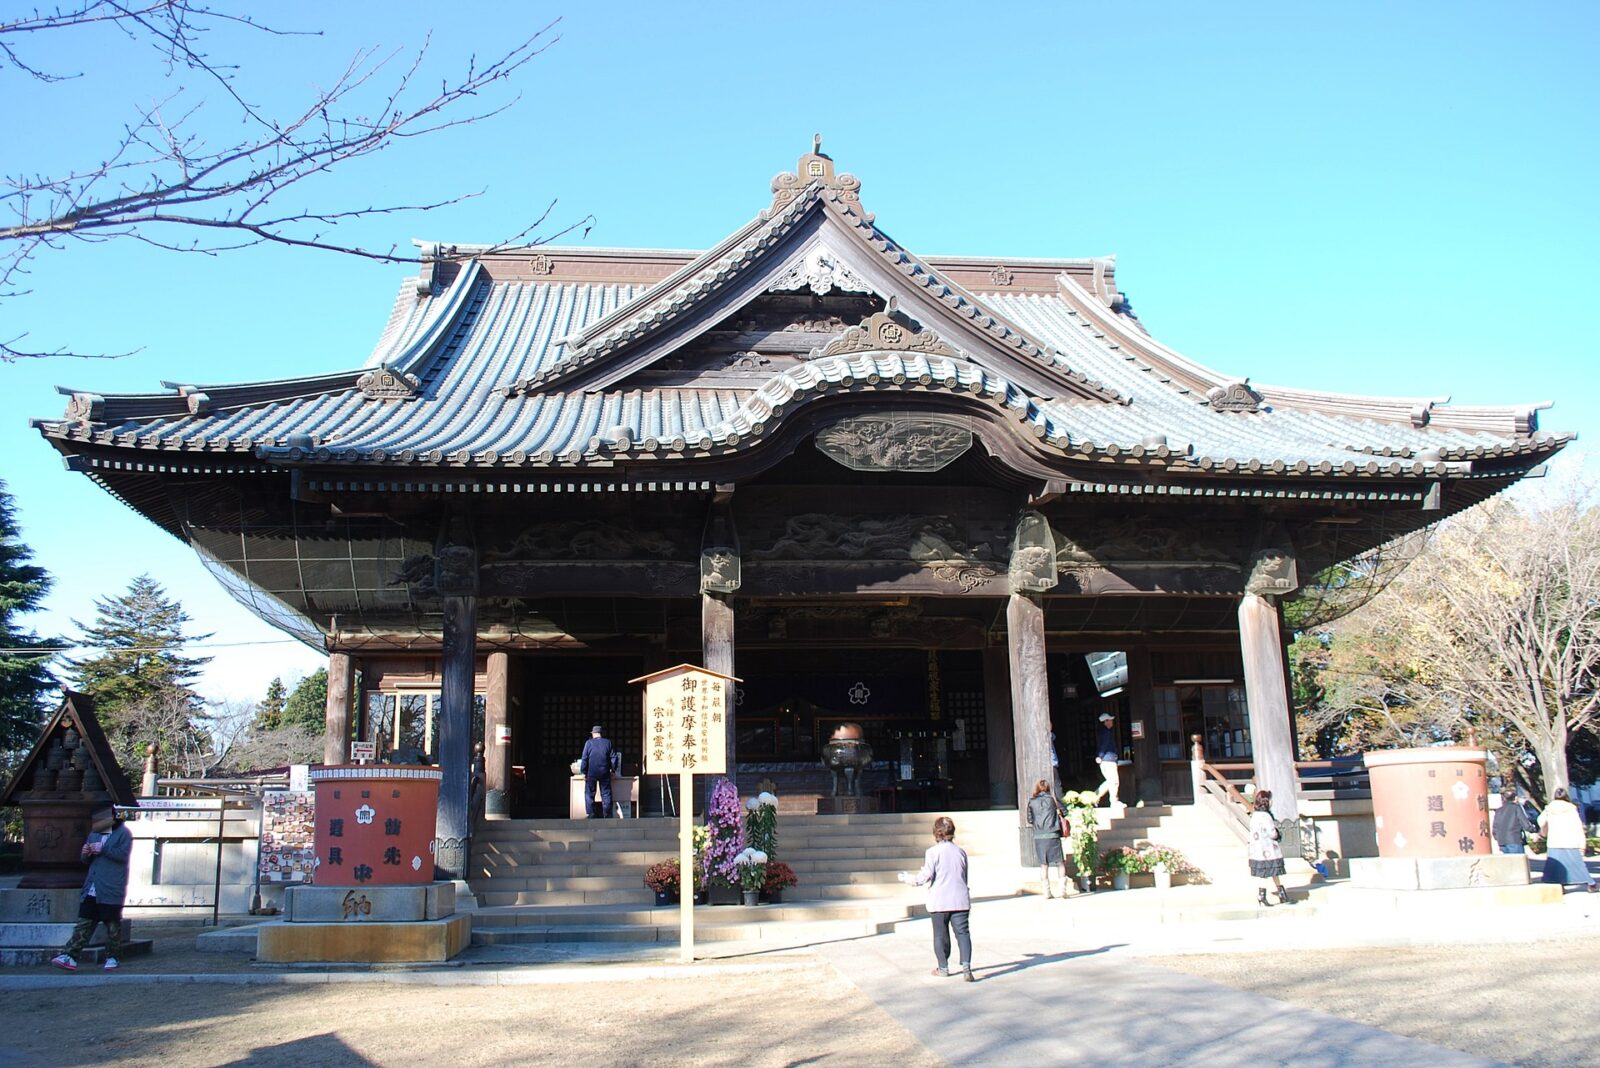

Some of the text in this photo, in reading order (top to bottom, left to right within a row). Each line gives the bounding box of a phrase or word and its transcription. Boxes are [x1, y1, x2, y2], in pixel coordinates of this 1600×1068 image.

[681, 677, 697, 768] 御護摩奉修
